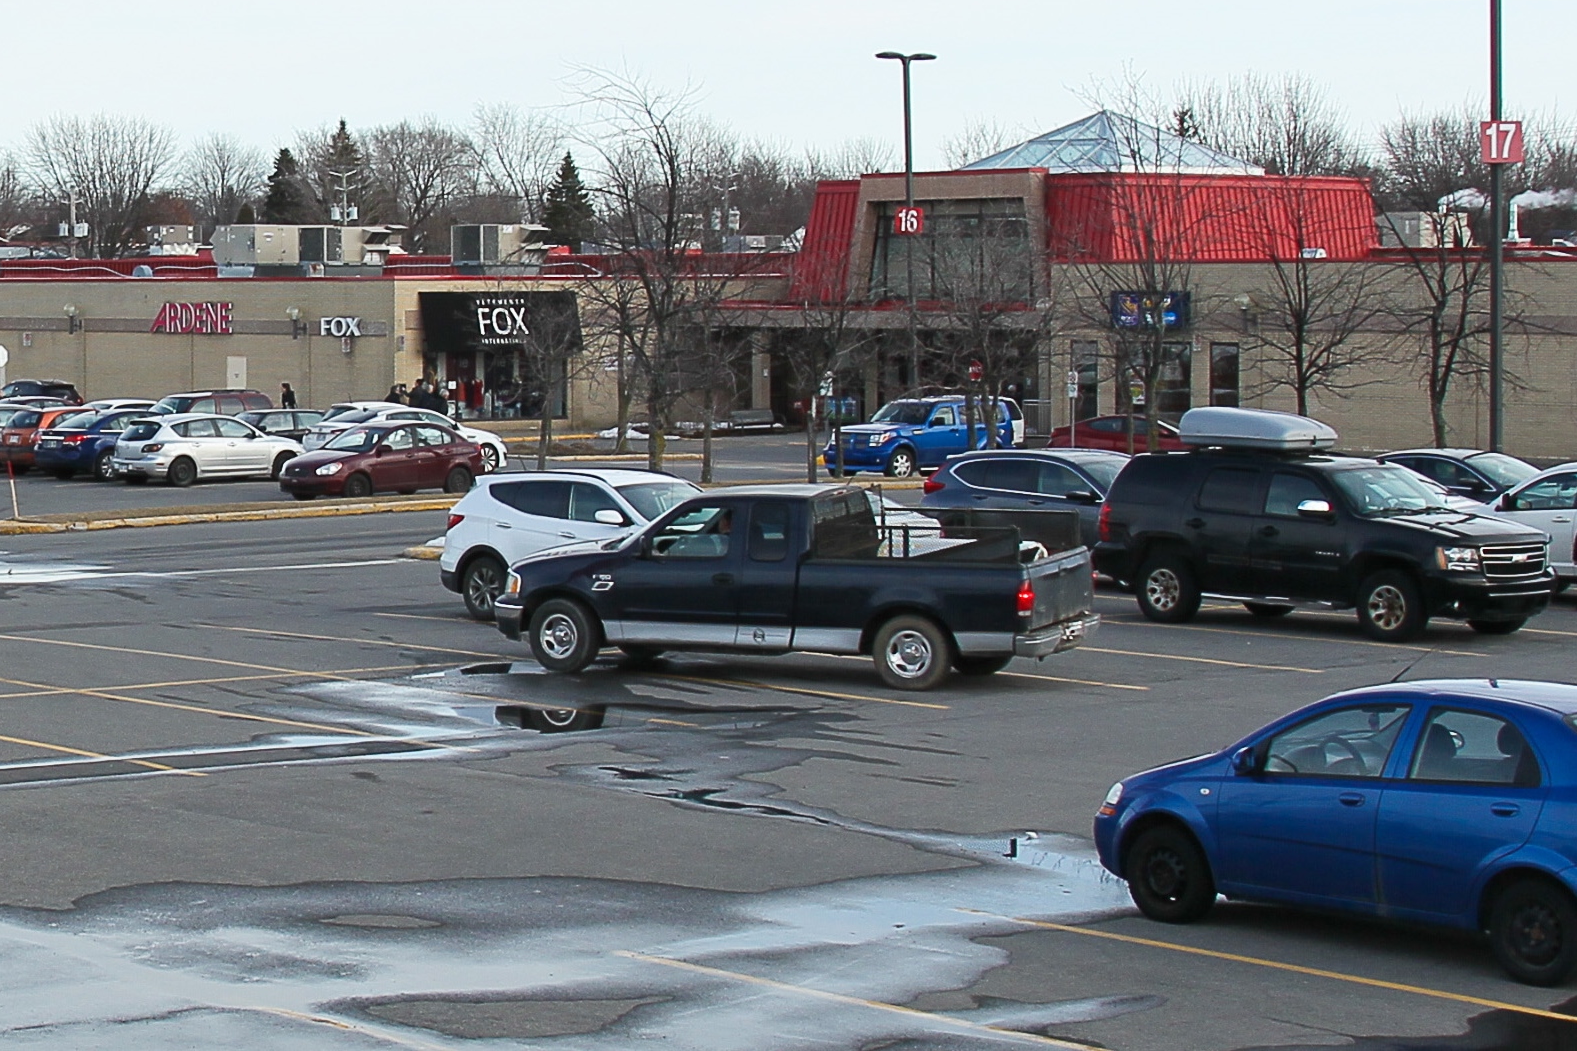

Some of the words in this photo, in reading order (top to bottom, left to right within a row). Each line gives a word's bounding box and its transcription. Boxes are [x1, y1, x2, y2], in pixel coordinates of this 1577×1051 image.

[1485, 122, 1516, 159] 17
[898, 209, 918, 232] 16
[150, 302, 232, 334] ARDENE
[320, 317, 361, 337] FOX
[477, 307, 529, 335] FOX
